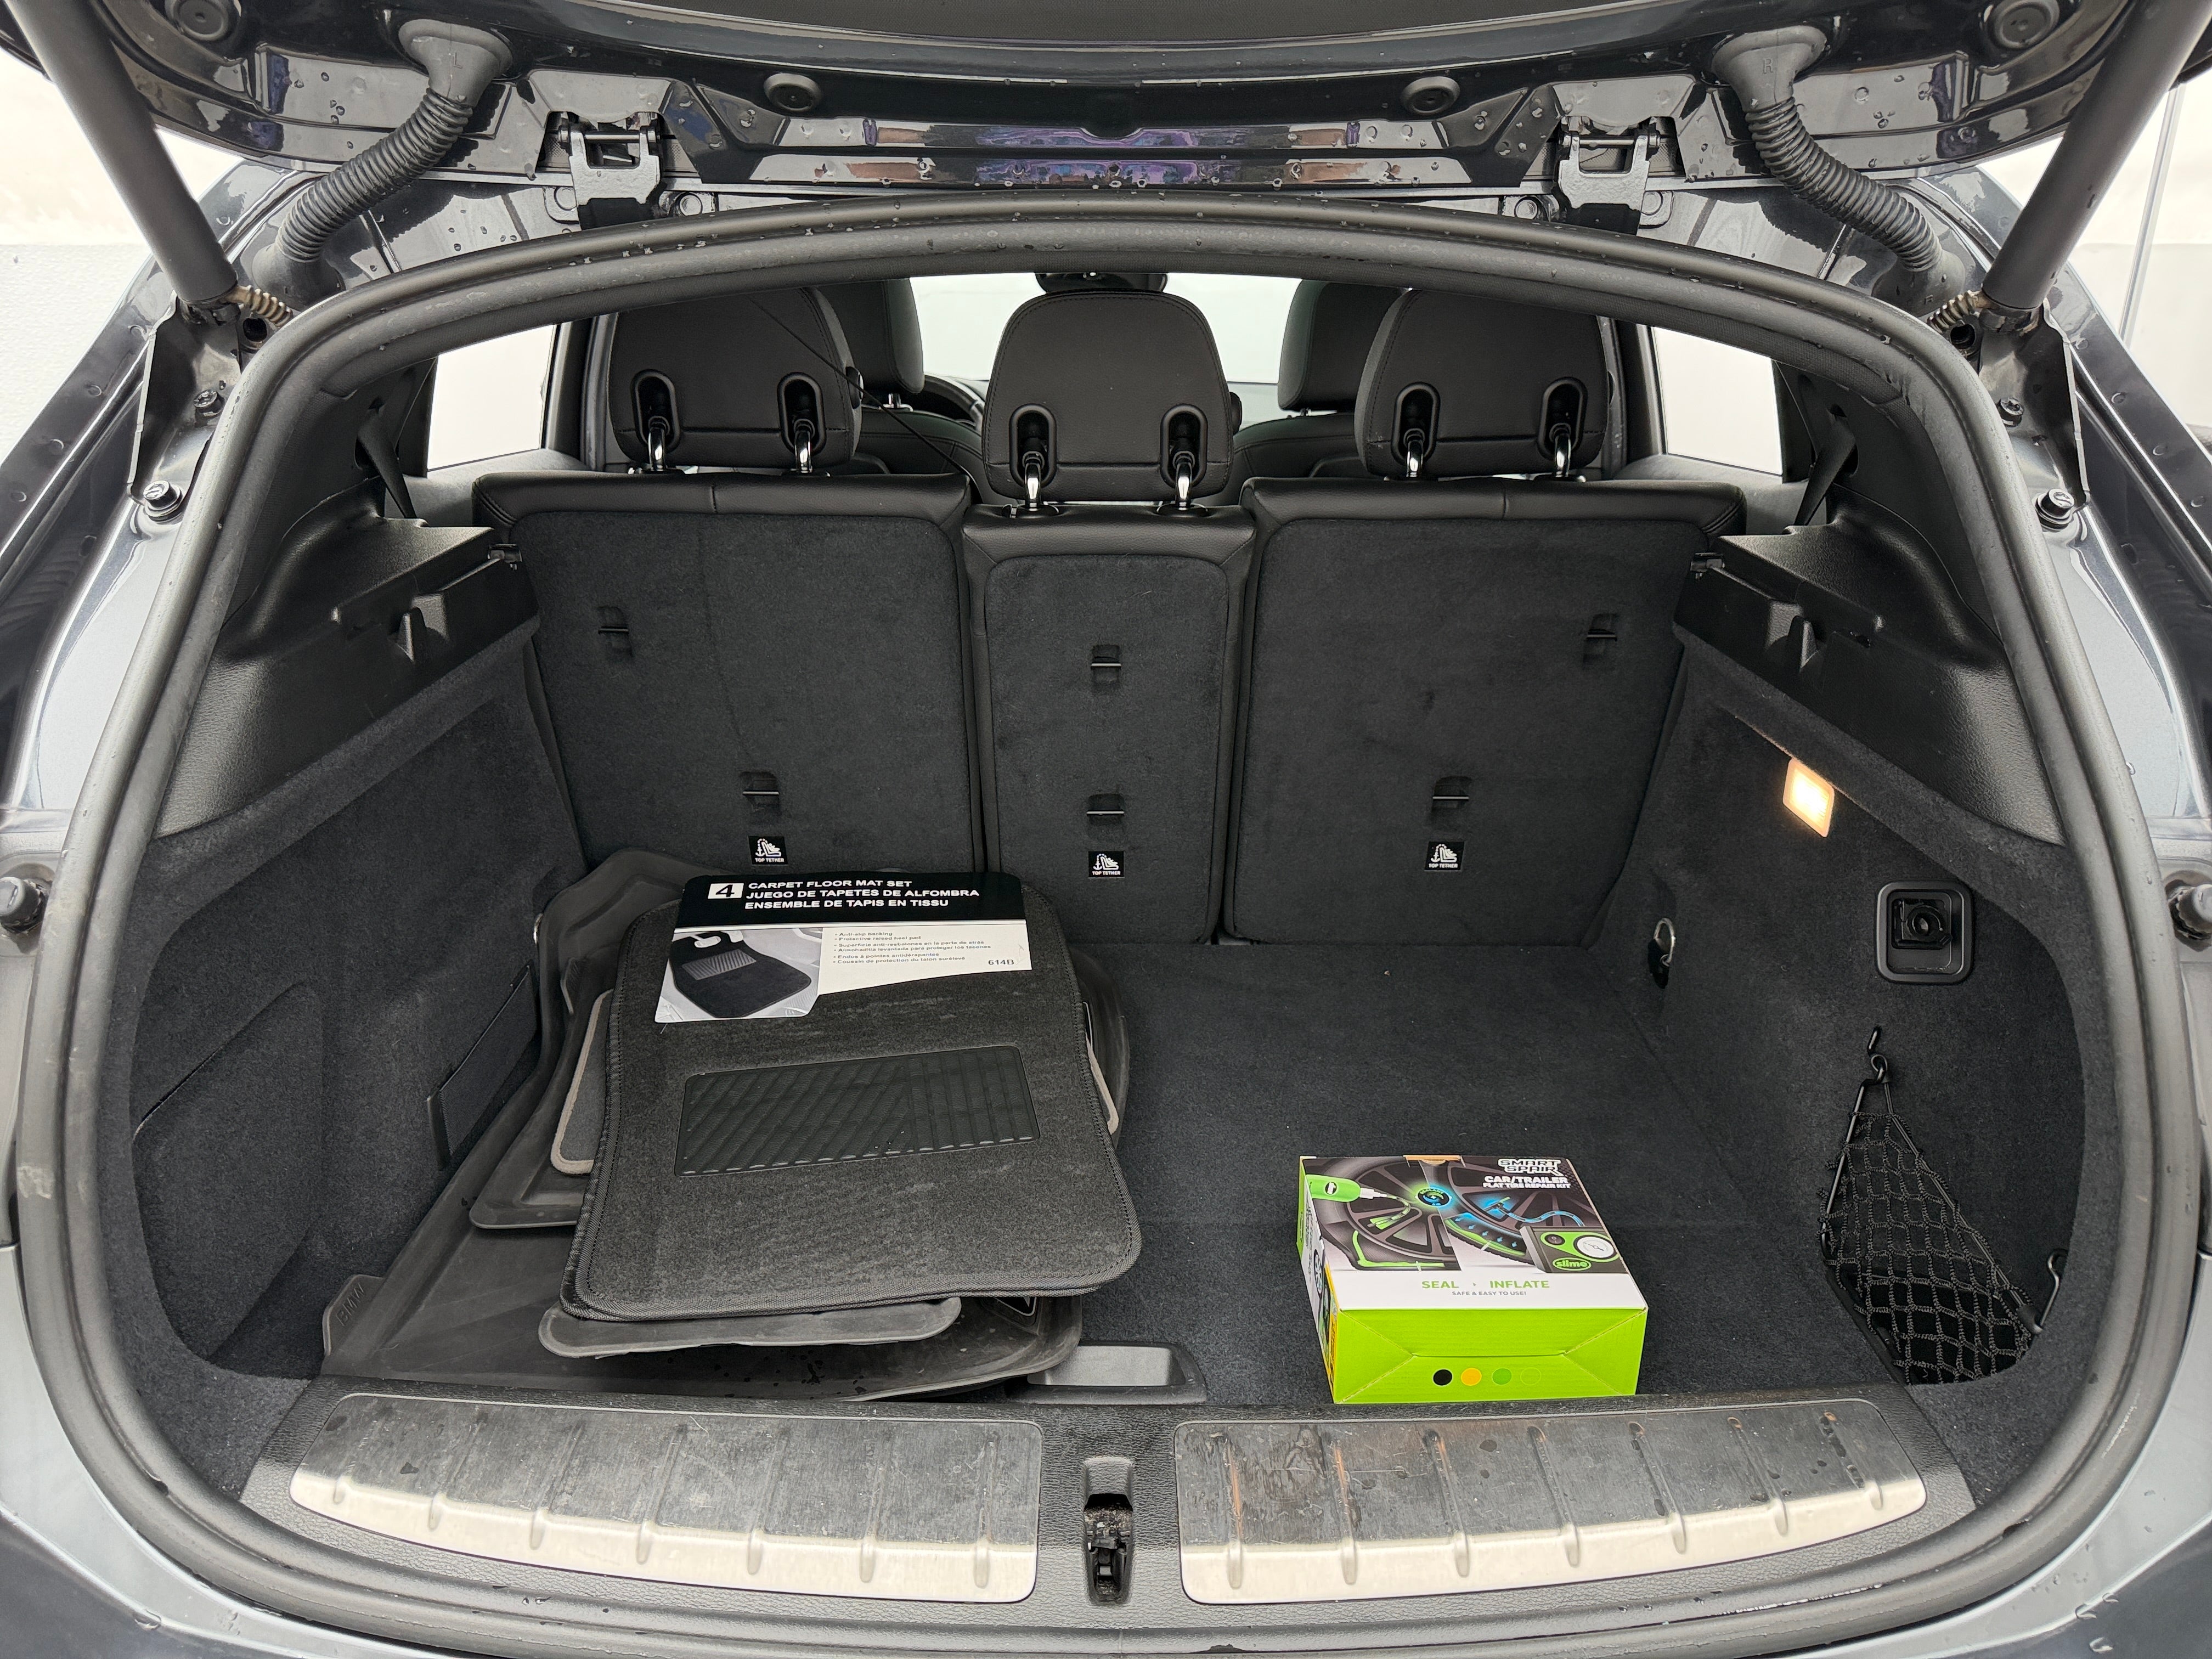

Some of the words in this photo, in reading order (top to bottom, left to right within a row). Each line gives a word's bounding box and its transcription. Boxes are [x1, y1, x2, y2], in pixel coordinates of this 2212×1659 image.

[1763, 58, 1773, 74] R
[715, 884, 735, 898] 4
[745, 900, 820, 909] ENSEMBLE
[1504, 1165, 1564, 1176] SPAIR
[1556, 1260, 1588, 1268] slime
[1421, 1280, 1459, 1289] SEAL
[335, 1282, 365, 1327] BMW
